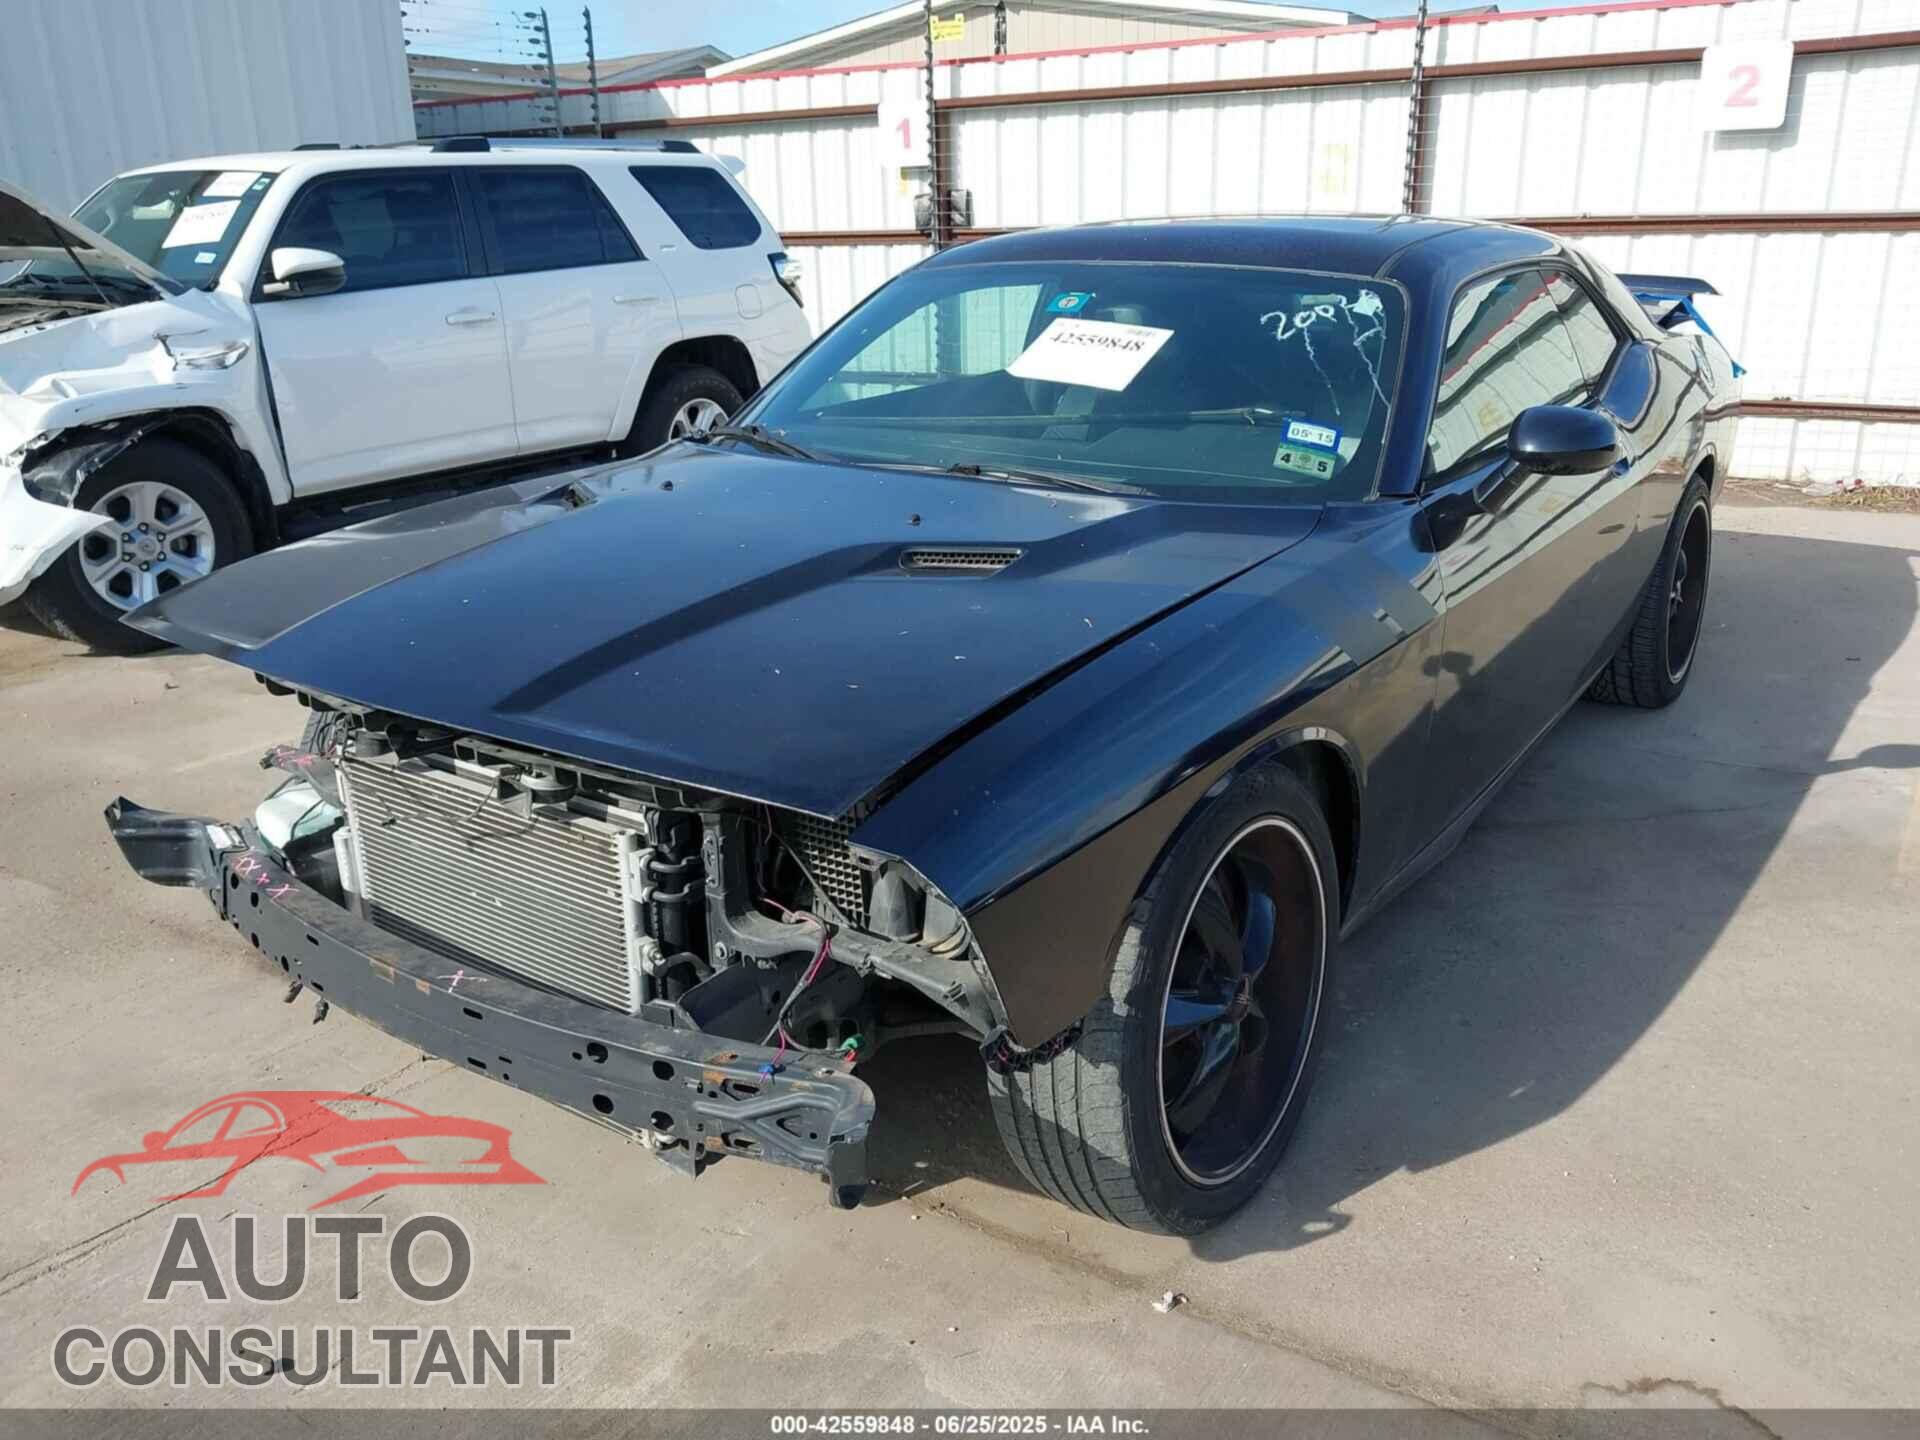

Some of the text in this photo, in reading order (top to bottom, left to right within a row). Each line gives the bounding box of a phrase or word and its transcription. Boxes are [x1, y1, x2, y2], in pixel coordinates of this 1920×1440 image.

[1725, 65, 1760, 108] 2
[895, 118, 911, 149] 1
[1049, 331, 1146, 352] 42559848
[1280, 453, 1293, 464] 4
[1316, 461, 1329, 473] 5
